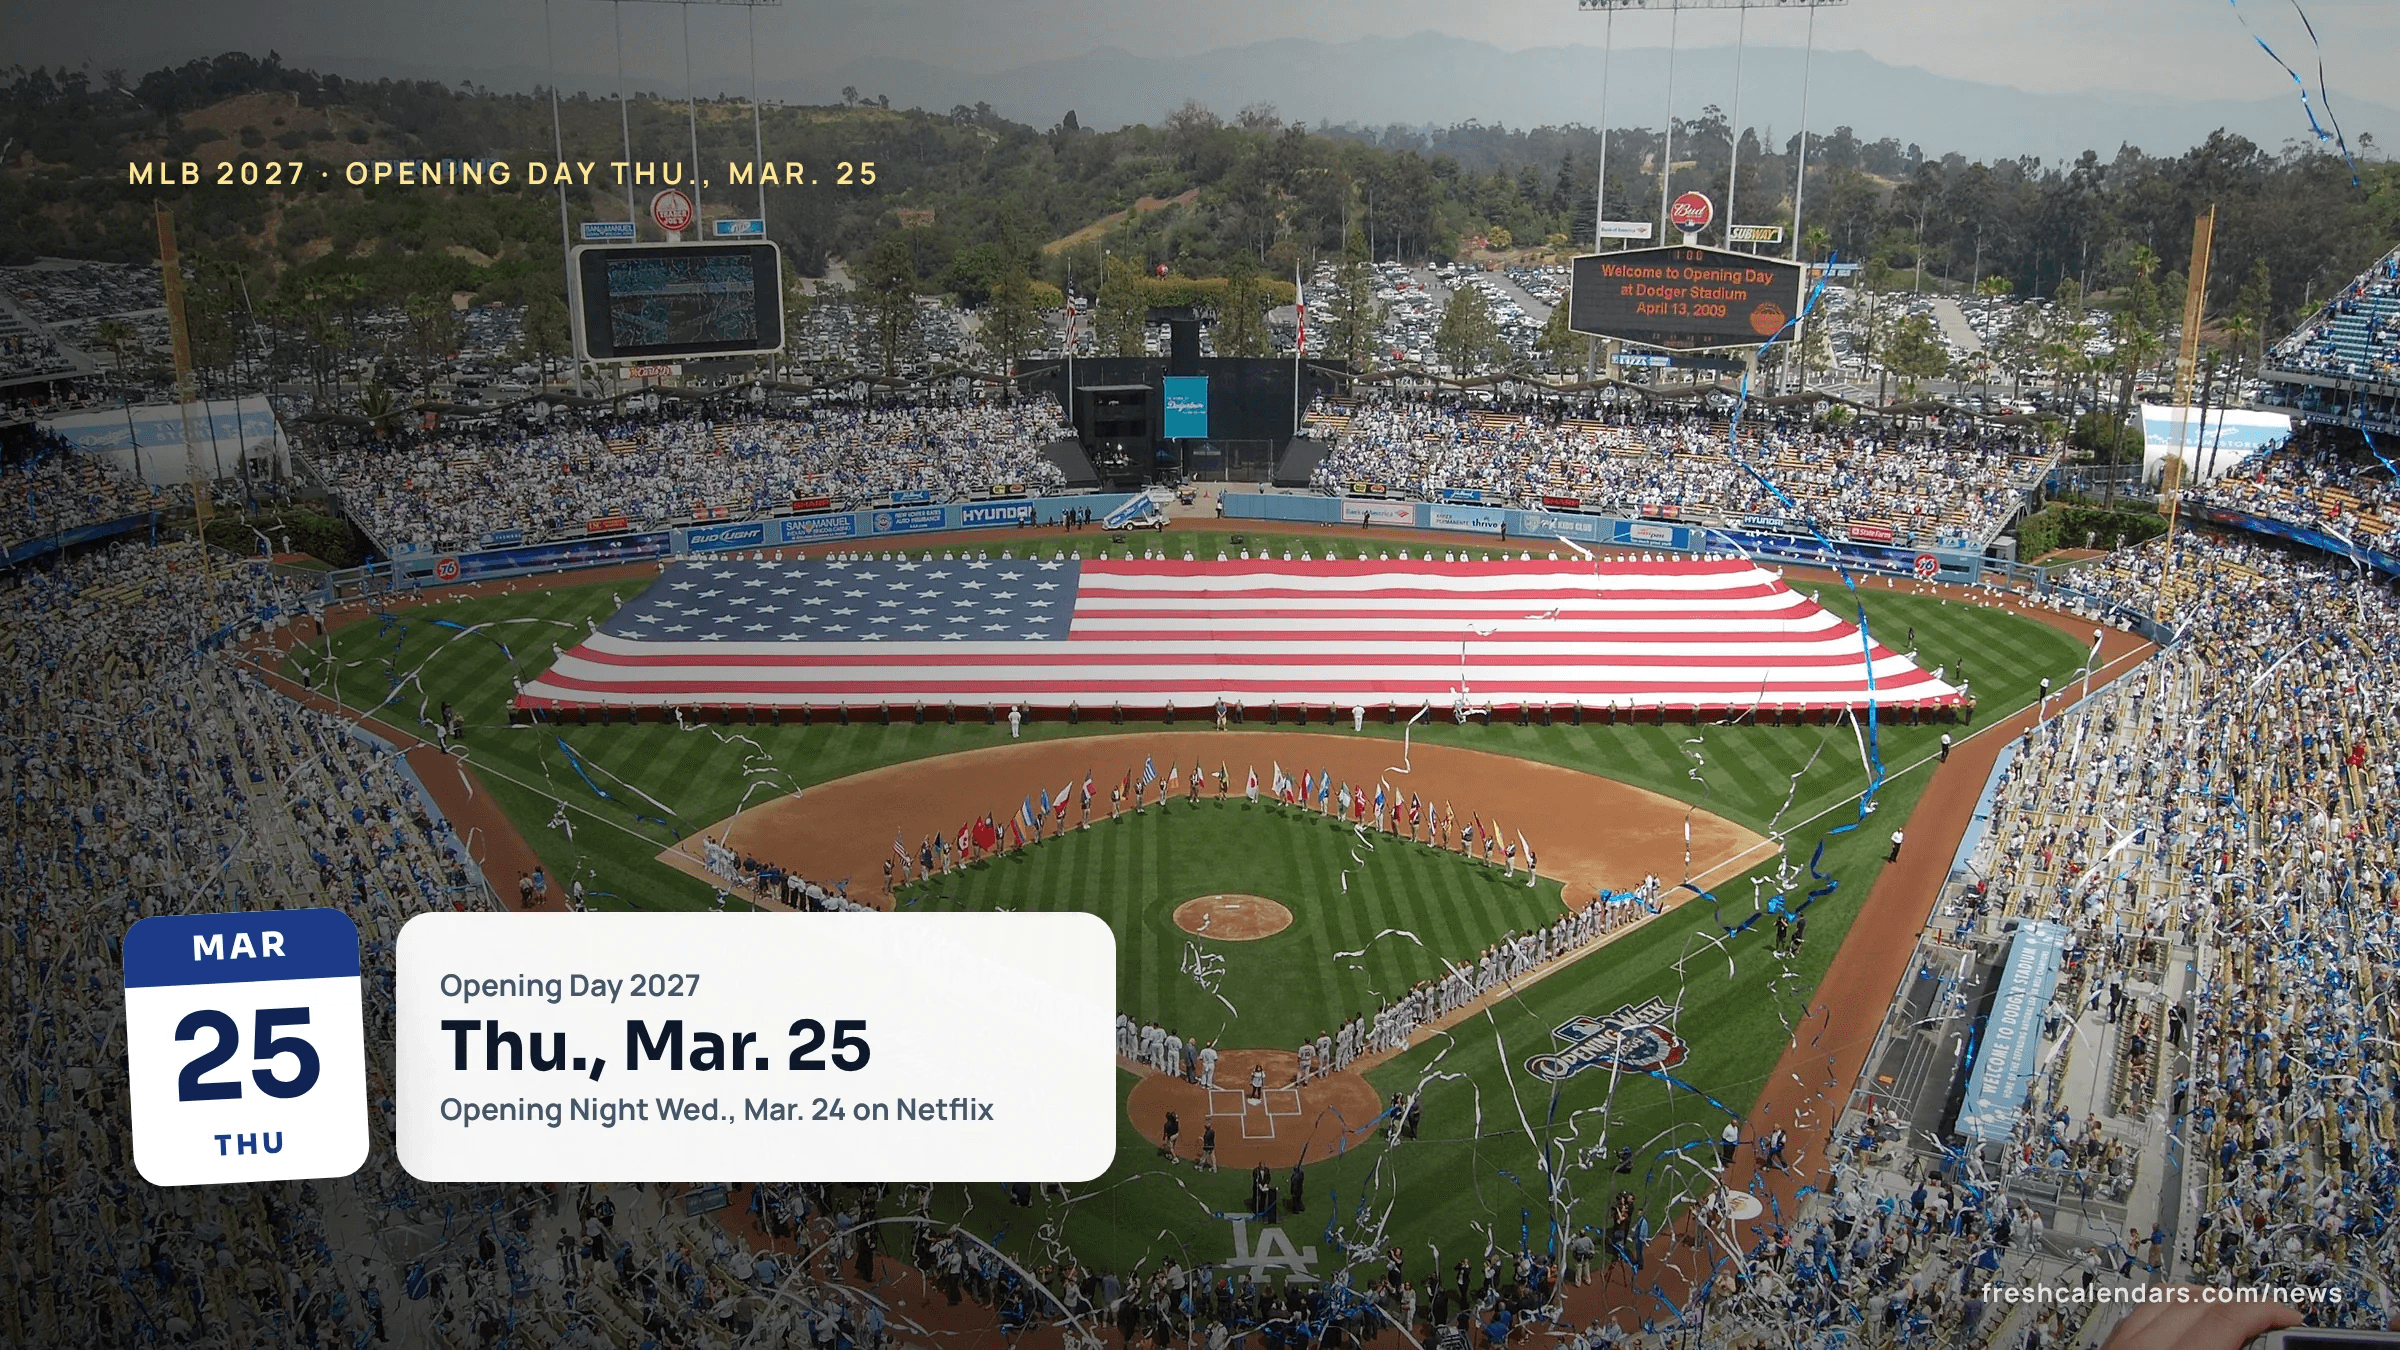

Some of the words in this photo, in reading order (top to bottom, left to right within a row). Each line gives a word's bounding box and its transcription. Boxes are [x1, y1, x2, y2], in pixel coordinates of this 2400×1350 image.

[1674, 203, 1707, 217] Bud
[1730, 227, 1779, 240] SUBWAY
[1601, 264, 1663, 279] Welcome
[1666, 267, 1680, 279] to
[1683, 267, 1742, 285] Opening
[1745, 269, 1774, 286] Day
[1620, 284, 1633, 296] at
[1636, 283, 1687, 300] Dodger
[1690, 286, 1747, 300] Stadium
[1637, 301, 1668, 316] April
[1672, 302, 1690, 317] 13,
[1693, 304, 1727, 318] 2009
[963, 505, 1033, 522] HYUNDAI
[1744, 515, 1784, 526] HYUNDAI
[786, 521, 805, 531] SAN
[813, 517, 851, 529] MANUEL
[690, 534, 720, 544] BUD
[724, 529, 761, 540] LIGHT
[440, 561, 456, 576] 76
[1918, 558, 1935, 574] 76
[2013, 947, 2036, 985] STADIUM
[2001, 986, 2026, 1025] DODGER
[1604, 1002, 1673, 1030] WEEK
[1996, 1027, 2014, 1040] TO
[1530, 1029, 1626, 1078] OPENING
[1982, 1042, 2010, 1094] WELCOME
[1223, 1212, 1321, 1283] LA
